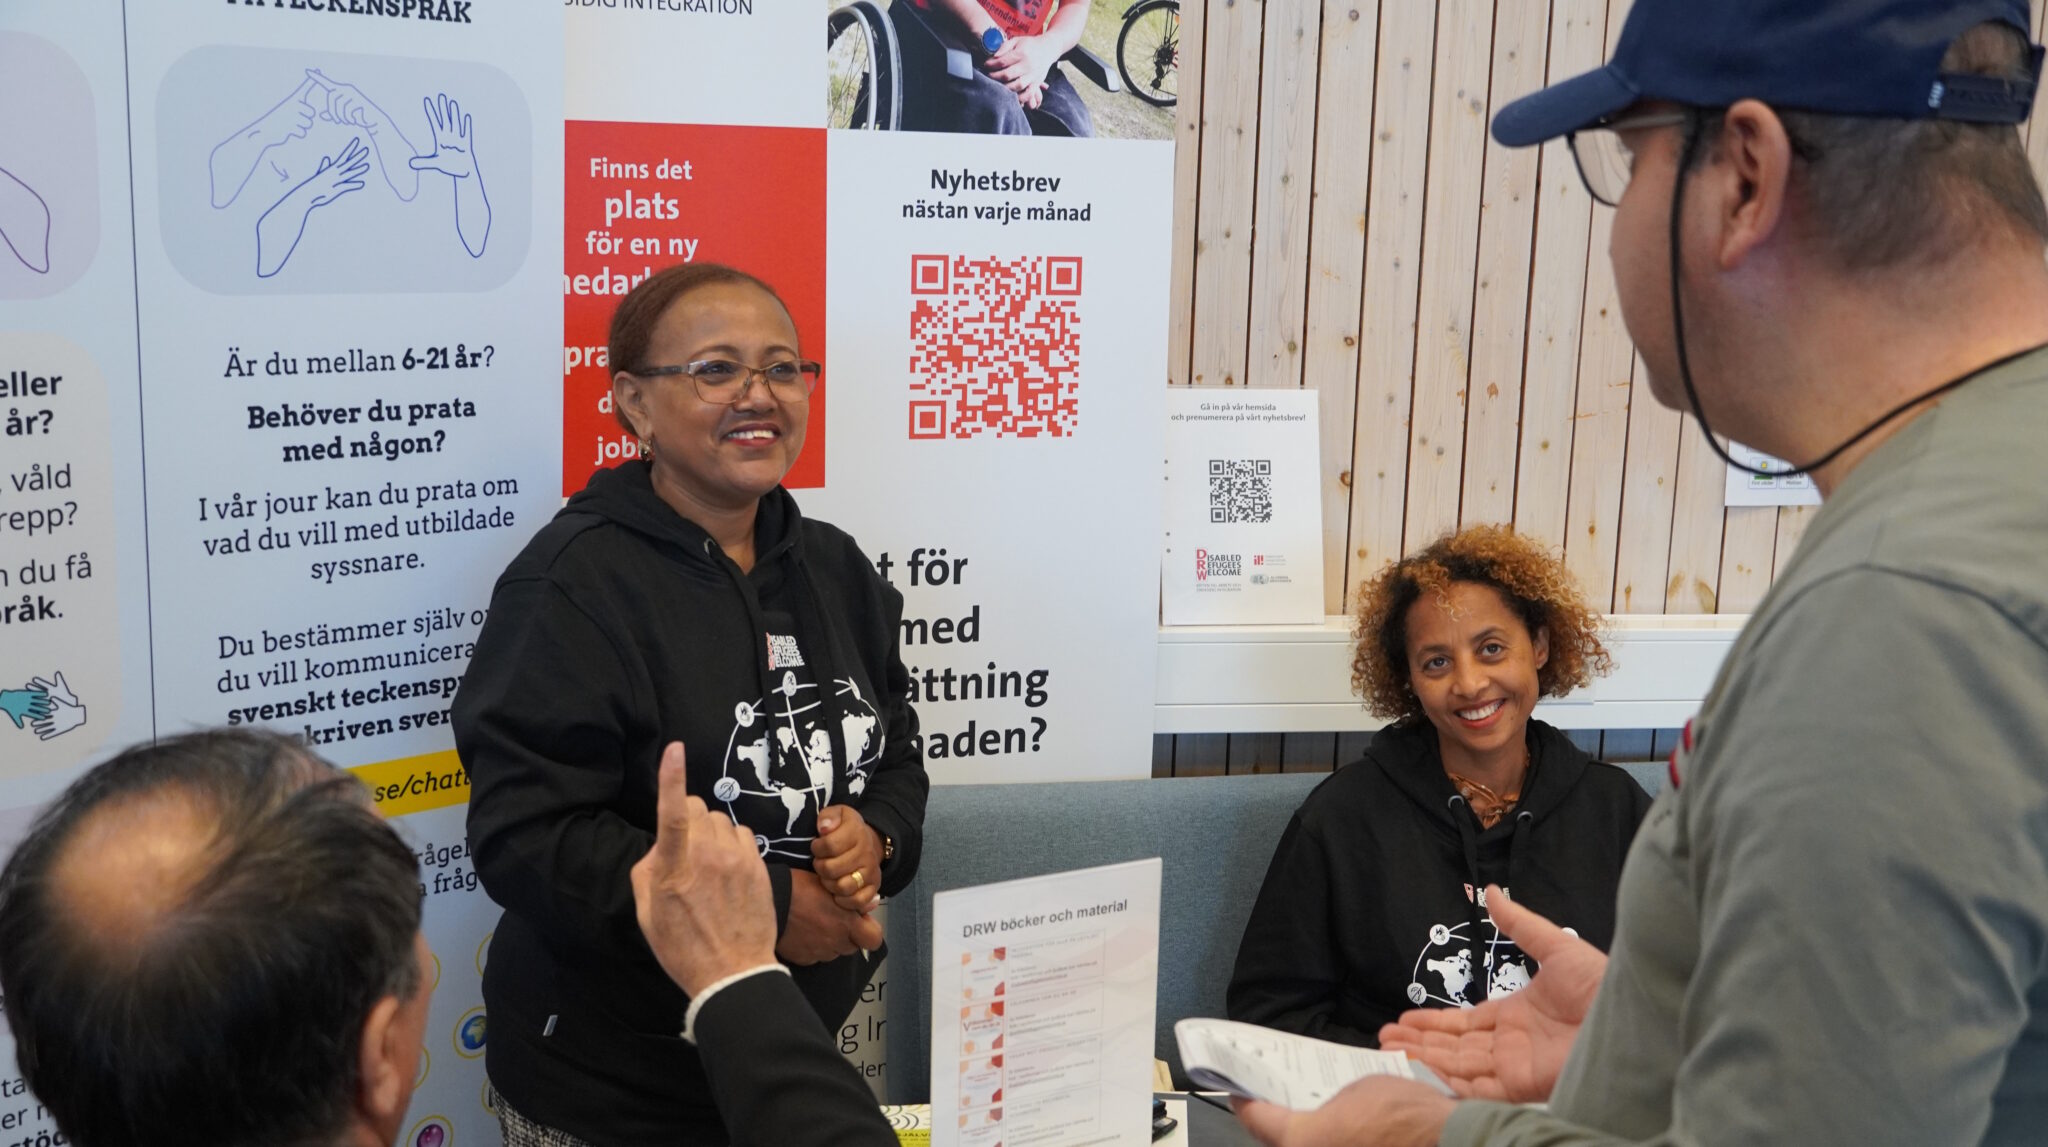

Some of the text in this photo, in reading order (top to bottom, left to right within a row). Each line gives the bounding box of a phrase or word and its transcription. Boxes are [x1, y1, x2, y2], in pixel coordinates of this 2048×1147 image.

[590, 157, 693, 180] Finns det
[931, 168, 1061, 196] Nyhetsbrev
[605, 189, 680, 227] plats
[902, 200, 1091, 225] nästan varje månad
[585, 230, 698, 262] för en ny
[224, 344, 495, 377] Är du mellan 6-21 år?
[6, 408, 53, 436] år?
[248, 398, 476, 429] Behöver du prata
[1171, 413, 1306, 423] och prenumerera på vårt nyhetsbrev!
[1200, 403, 1276, 413] Gå in på vår hemsida
[283, 430, 446, 462] med någon?
[11, 463, 71, 492] våld
[199, 478, 519, 522] I vår jour kan du prata om
[203, 506, 515, 556] vad du vill med utbildade
[20, 559, 55, 585] du
[66, 552, 91, 580] få
[311, 552, 425, 584] syssnare.
[907, 548, 968, 586] för
[0, 595, 63, 624] råk.
[218, 608, 489, 659] Du bestämmer själv o
[217, 641, 476, 693] du vill kommunicera
[228, 690, 336, 726] svenskt
[303, 718, 394, 746] kriven
[963, 899, 1128, 938] DRW böcker och material
